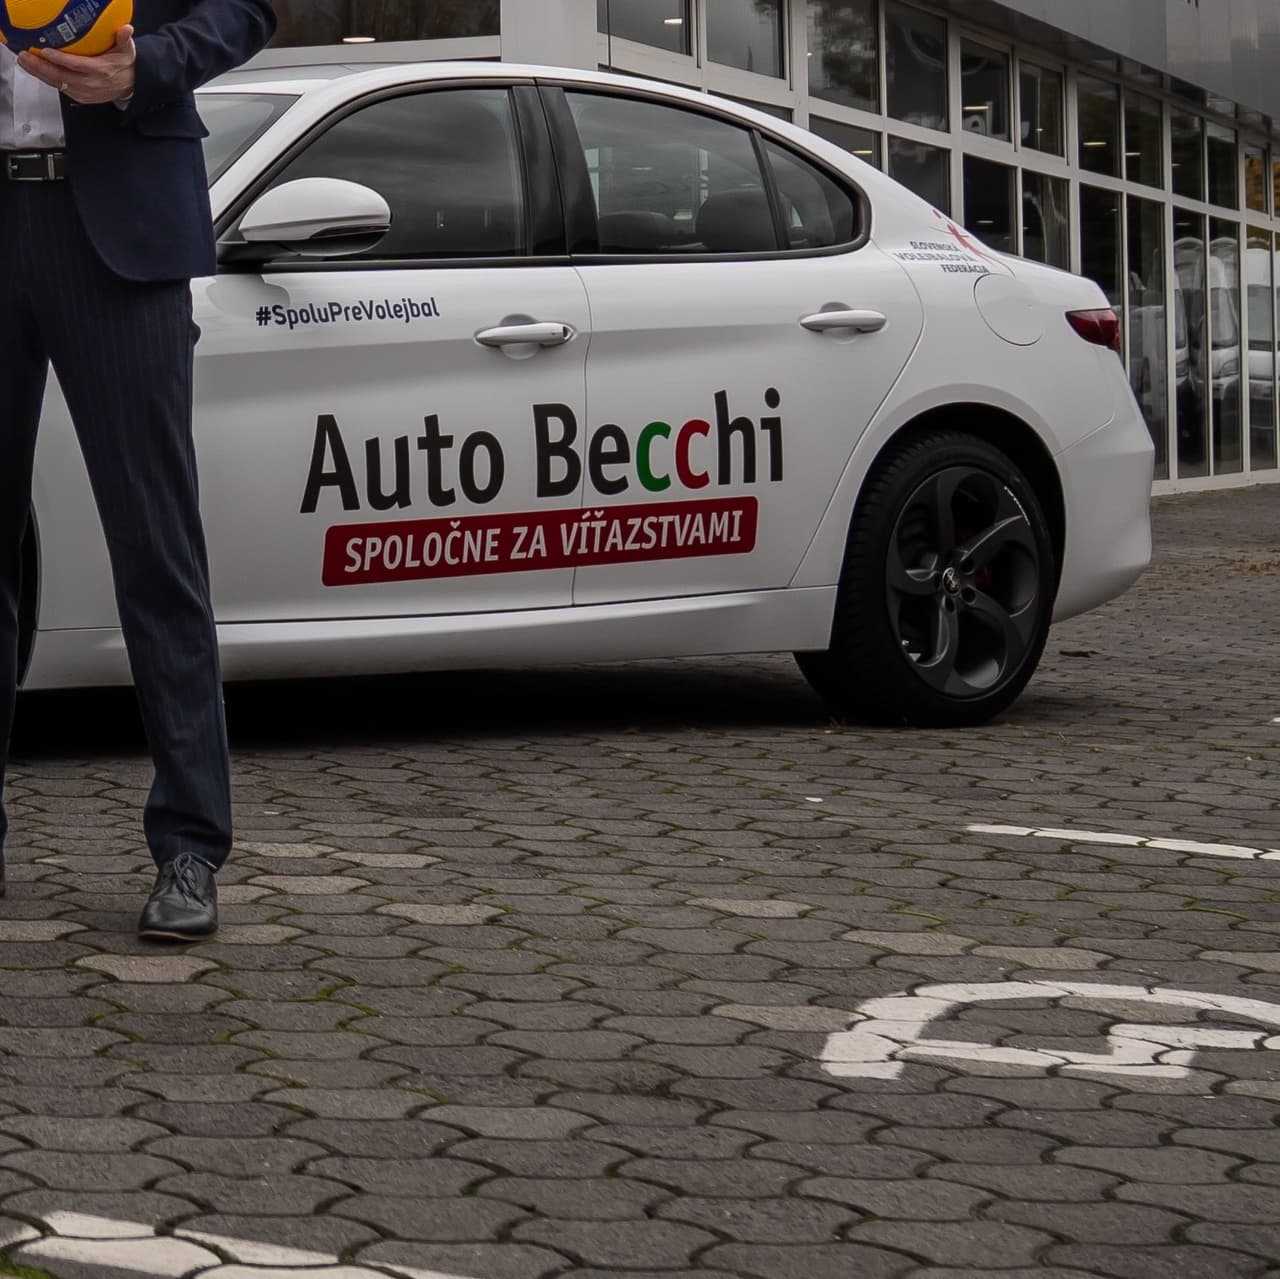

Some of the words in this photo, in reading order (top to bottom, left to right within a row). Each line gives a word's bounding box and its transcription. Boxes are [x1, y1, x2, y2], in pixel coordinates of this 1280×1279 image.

[940, 262, 991, 274] FEDERÁCIA
[256, 297, 440, 330] #SpoluPreVolejbal
[300, 413, 505, 514] Auto
[533, 387, 784, 498] Becchi
[344, 520, 501, 573] SPOLOČNE
[510, 524, 548, 560] ZA
[561, 509, 743, 556] VÍŤAZSTVAMI
